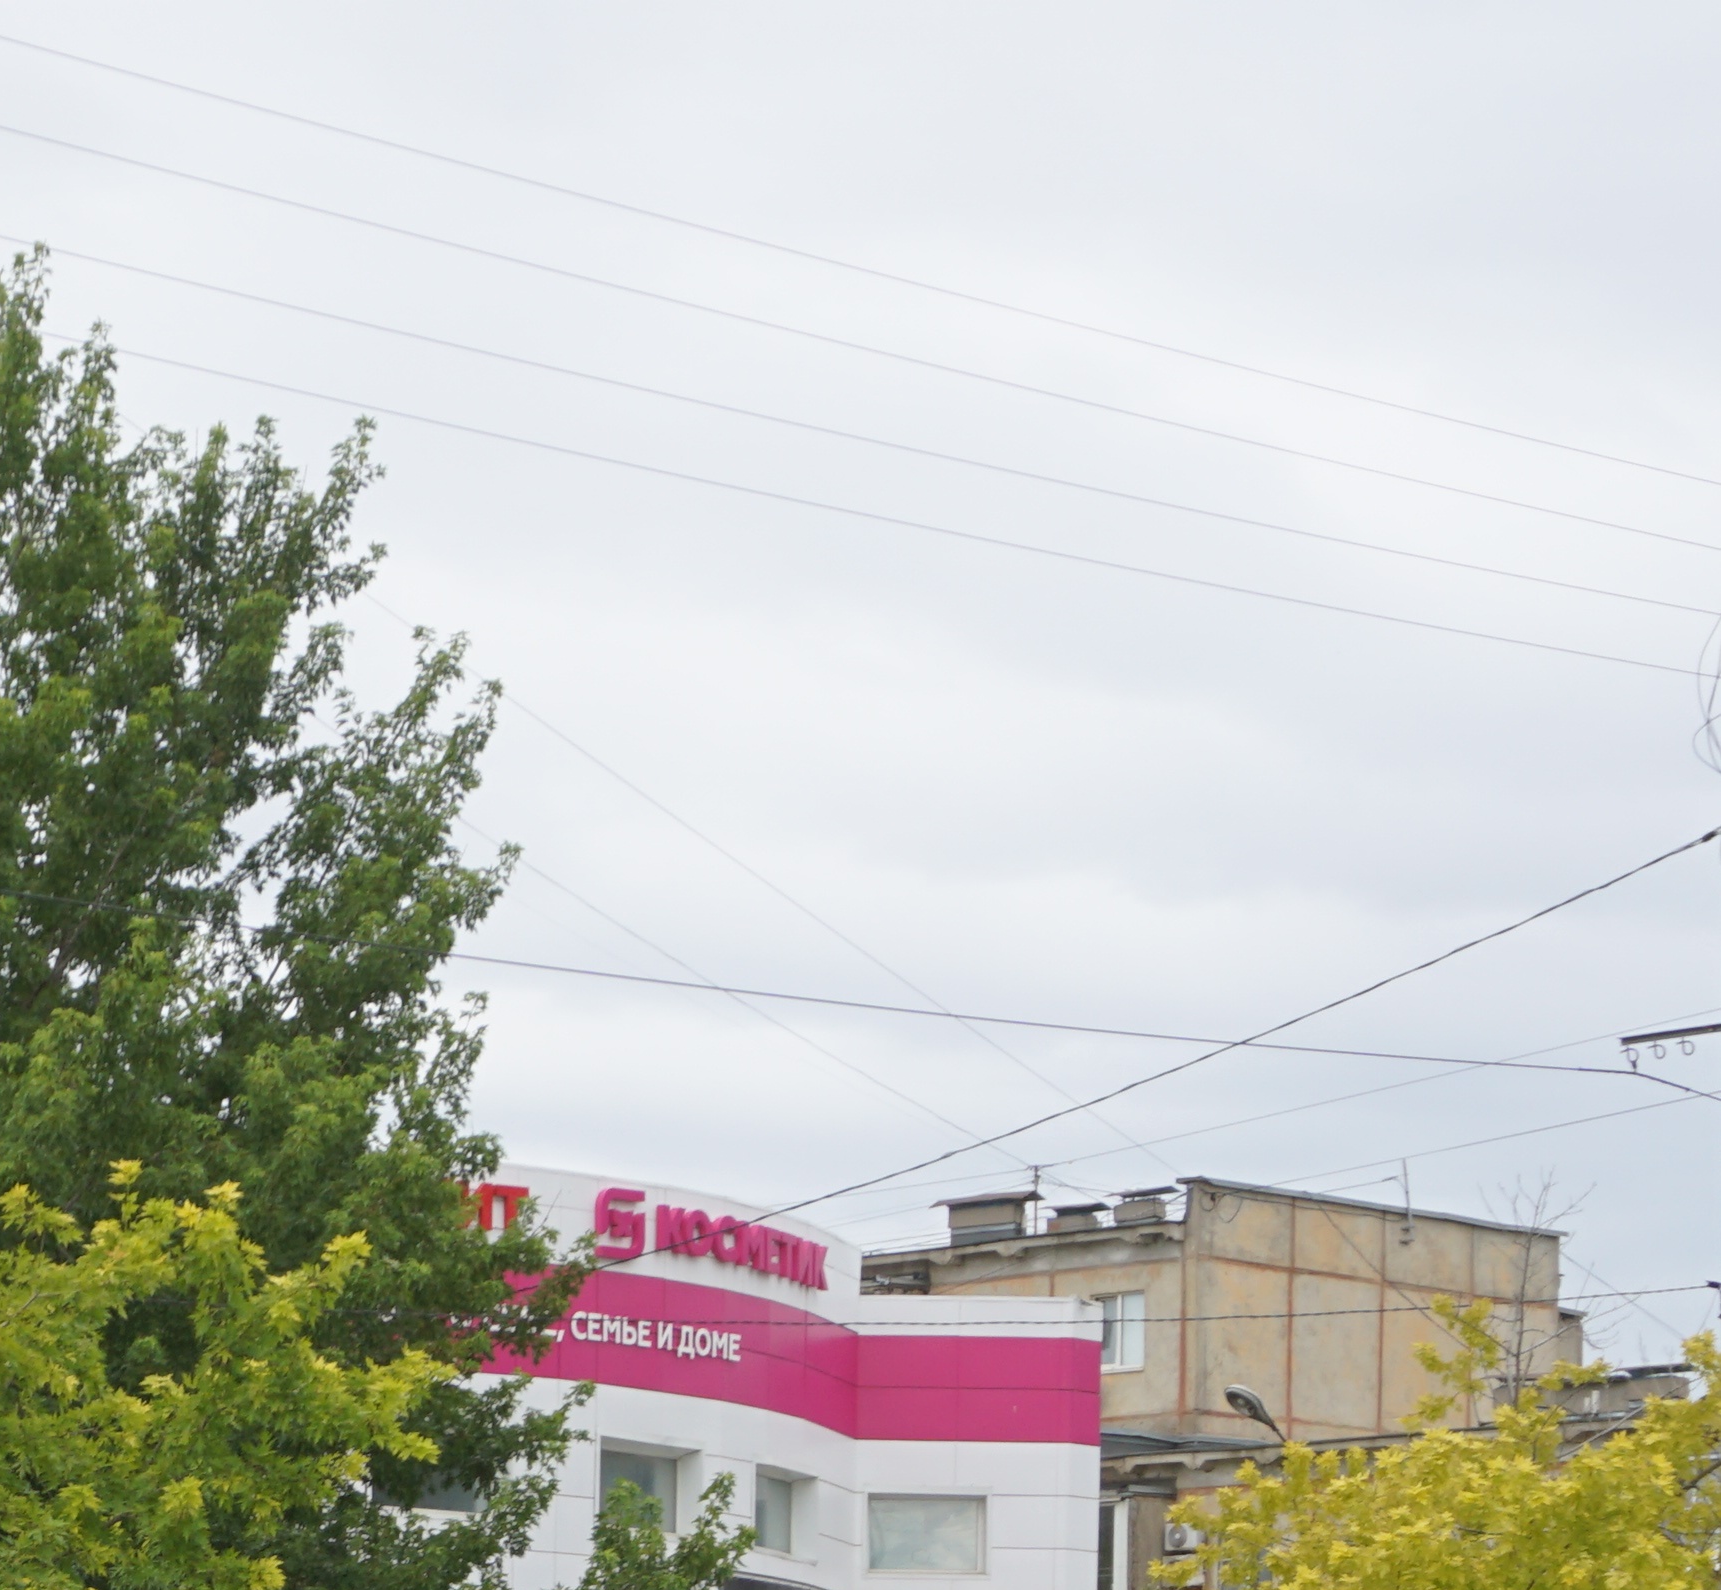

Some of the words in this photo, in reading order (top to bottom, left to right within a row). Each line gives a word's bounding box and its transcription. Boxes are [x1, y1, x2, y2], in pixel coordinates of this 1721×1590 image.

[656, 1204, 829, 1291] КОСМЕТИК
[570, 1311, 652, 1347] СЕМЬЕ
[657, 1321, 673, 1351] И
[677, 1325, 742, 1362] ДОМЕ
